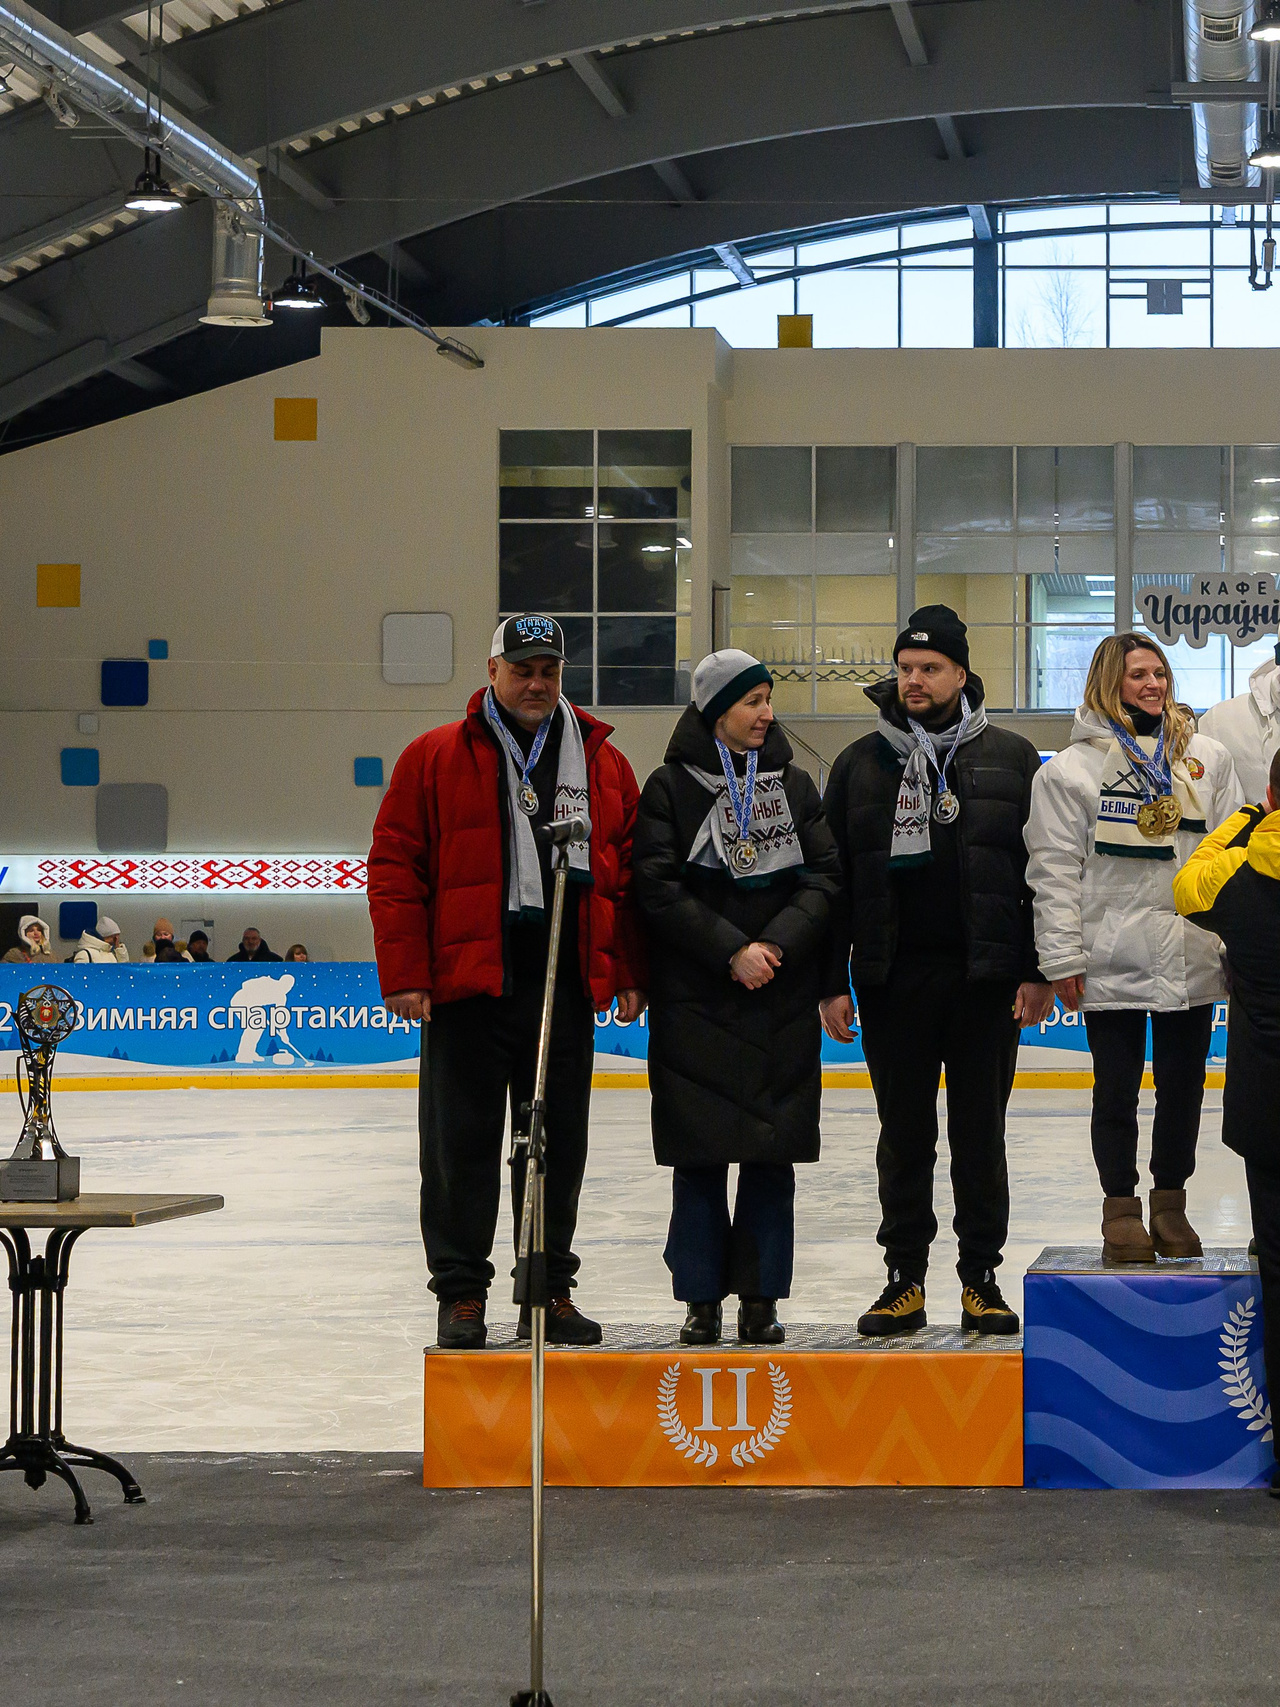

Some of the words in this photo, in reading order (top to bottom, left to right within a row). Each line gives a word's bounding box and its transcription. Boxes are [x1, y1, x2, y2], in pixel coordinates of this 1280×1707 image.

[1200, 581, 1267, 595] КАФЕ
[515, 618, 554, 631] DINAMO
[1101, 800, 1136, 815] БЕЛЫЕ
[71, 1000, 199, 1031] Зимняя
[693, 1368, 756, 1431] II
